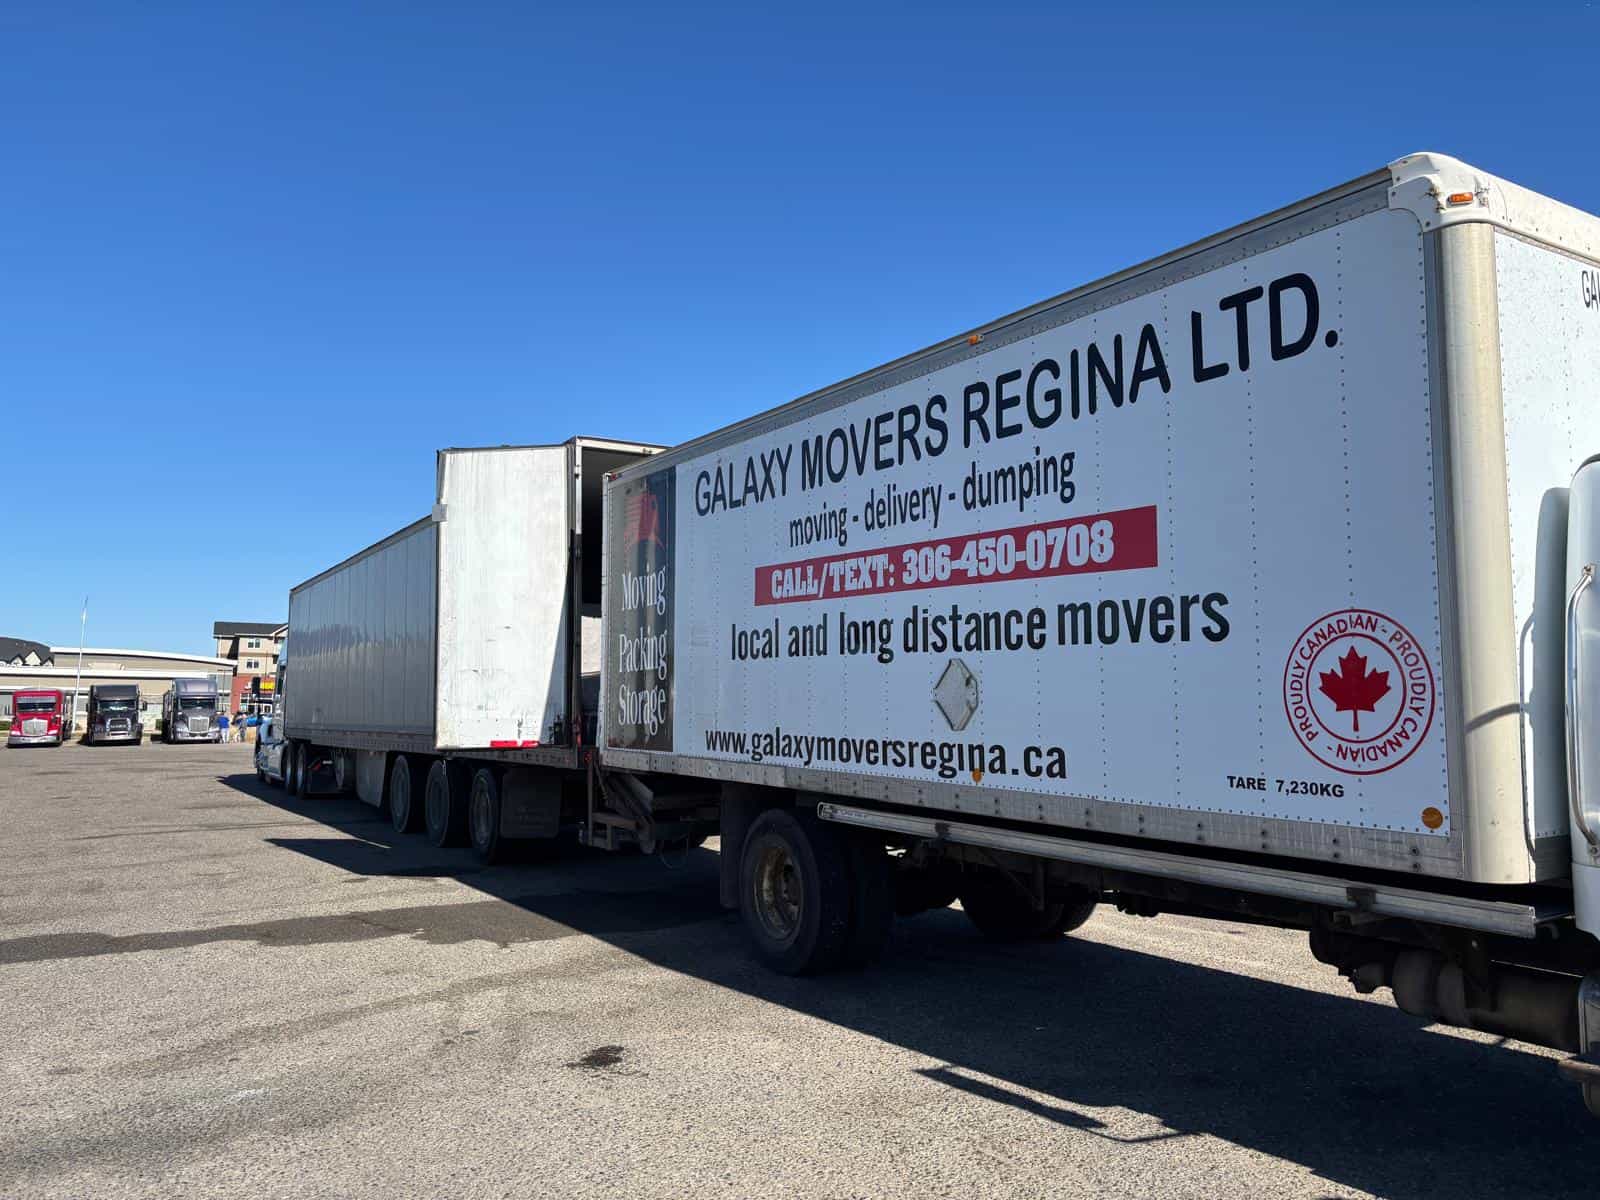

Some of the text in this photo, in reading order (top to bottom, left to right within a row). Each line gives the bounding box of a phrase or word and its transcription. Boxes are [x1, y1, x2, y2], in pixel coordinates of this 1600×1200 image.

[695, 272, 1339, 517] GALAXY MOVERS REGINA LTD.
[789, 502, 848, 547] moving
[864, 482, 942, 532] delivery
[963, 446, 1075, 512] dumping
[771, 519, 1114, 599] CALL/TEXT: 306-450-0708
[622, 562, 667, 616] Moving
[619, 627, 668, 681] Packing
[731, 592, 1231, 664] local and long distance movers
[1299, 613, 1378, 660] CANADIAN
[1388, 630, 1426, 717] PROUDLY
[618, 683, 667, 736] Storage
[1289, 660, 1319, 742] PROUDLY
[705, 727, 1067, 779] www.galaxymoversregina.ca
[1336, 716, 1418, 763] CANADIAN
[1226, 775, 1345, 798] TARE 7,230KG
